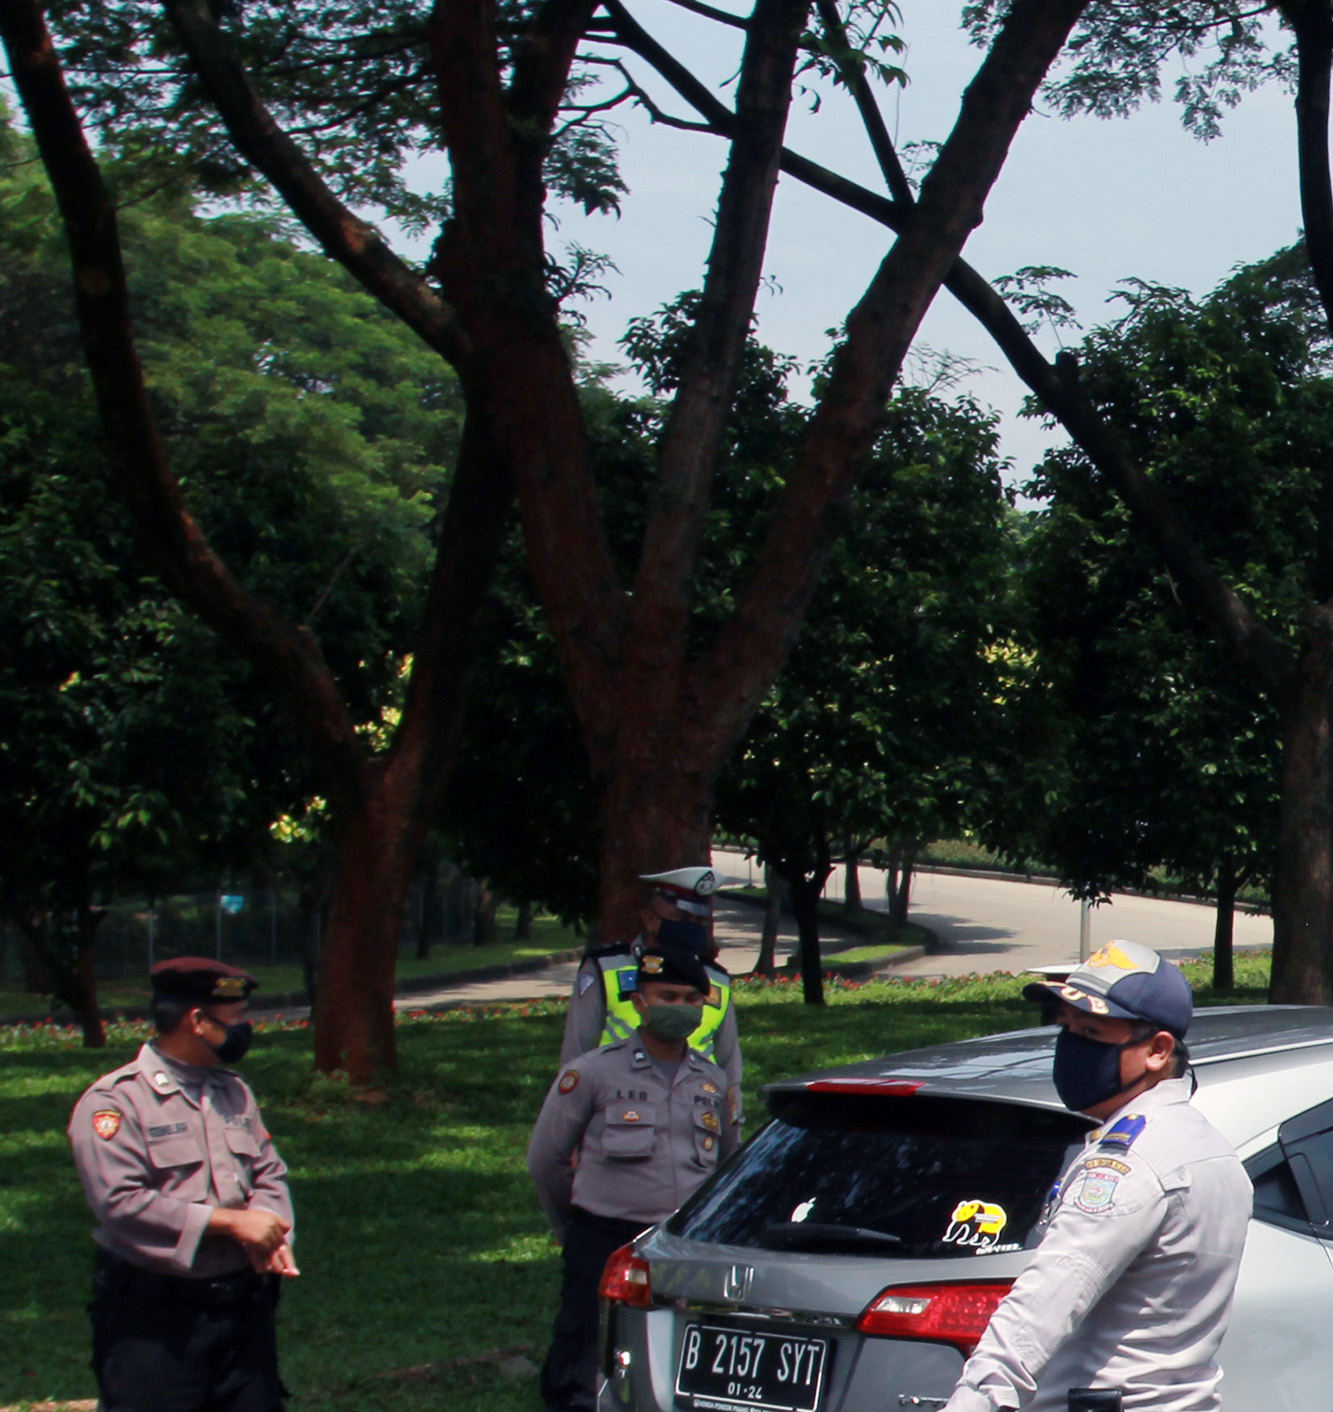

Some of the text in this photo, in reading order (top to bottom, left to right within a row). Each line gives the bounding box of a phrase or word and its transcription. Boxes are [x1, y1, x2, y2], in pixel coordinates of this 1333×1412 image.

[685, 1331, 820, 1385] B 2157 SYT
